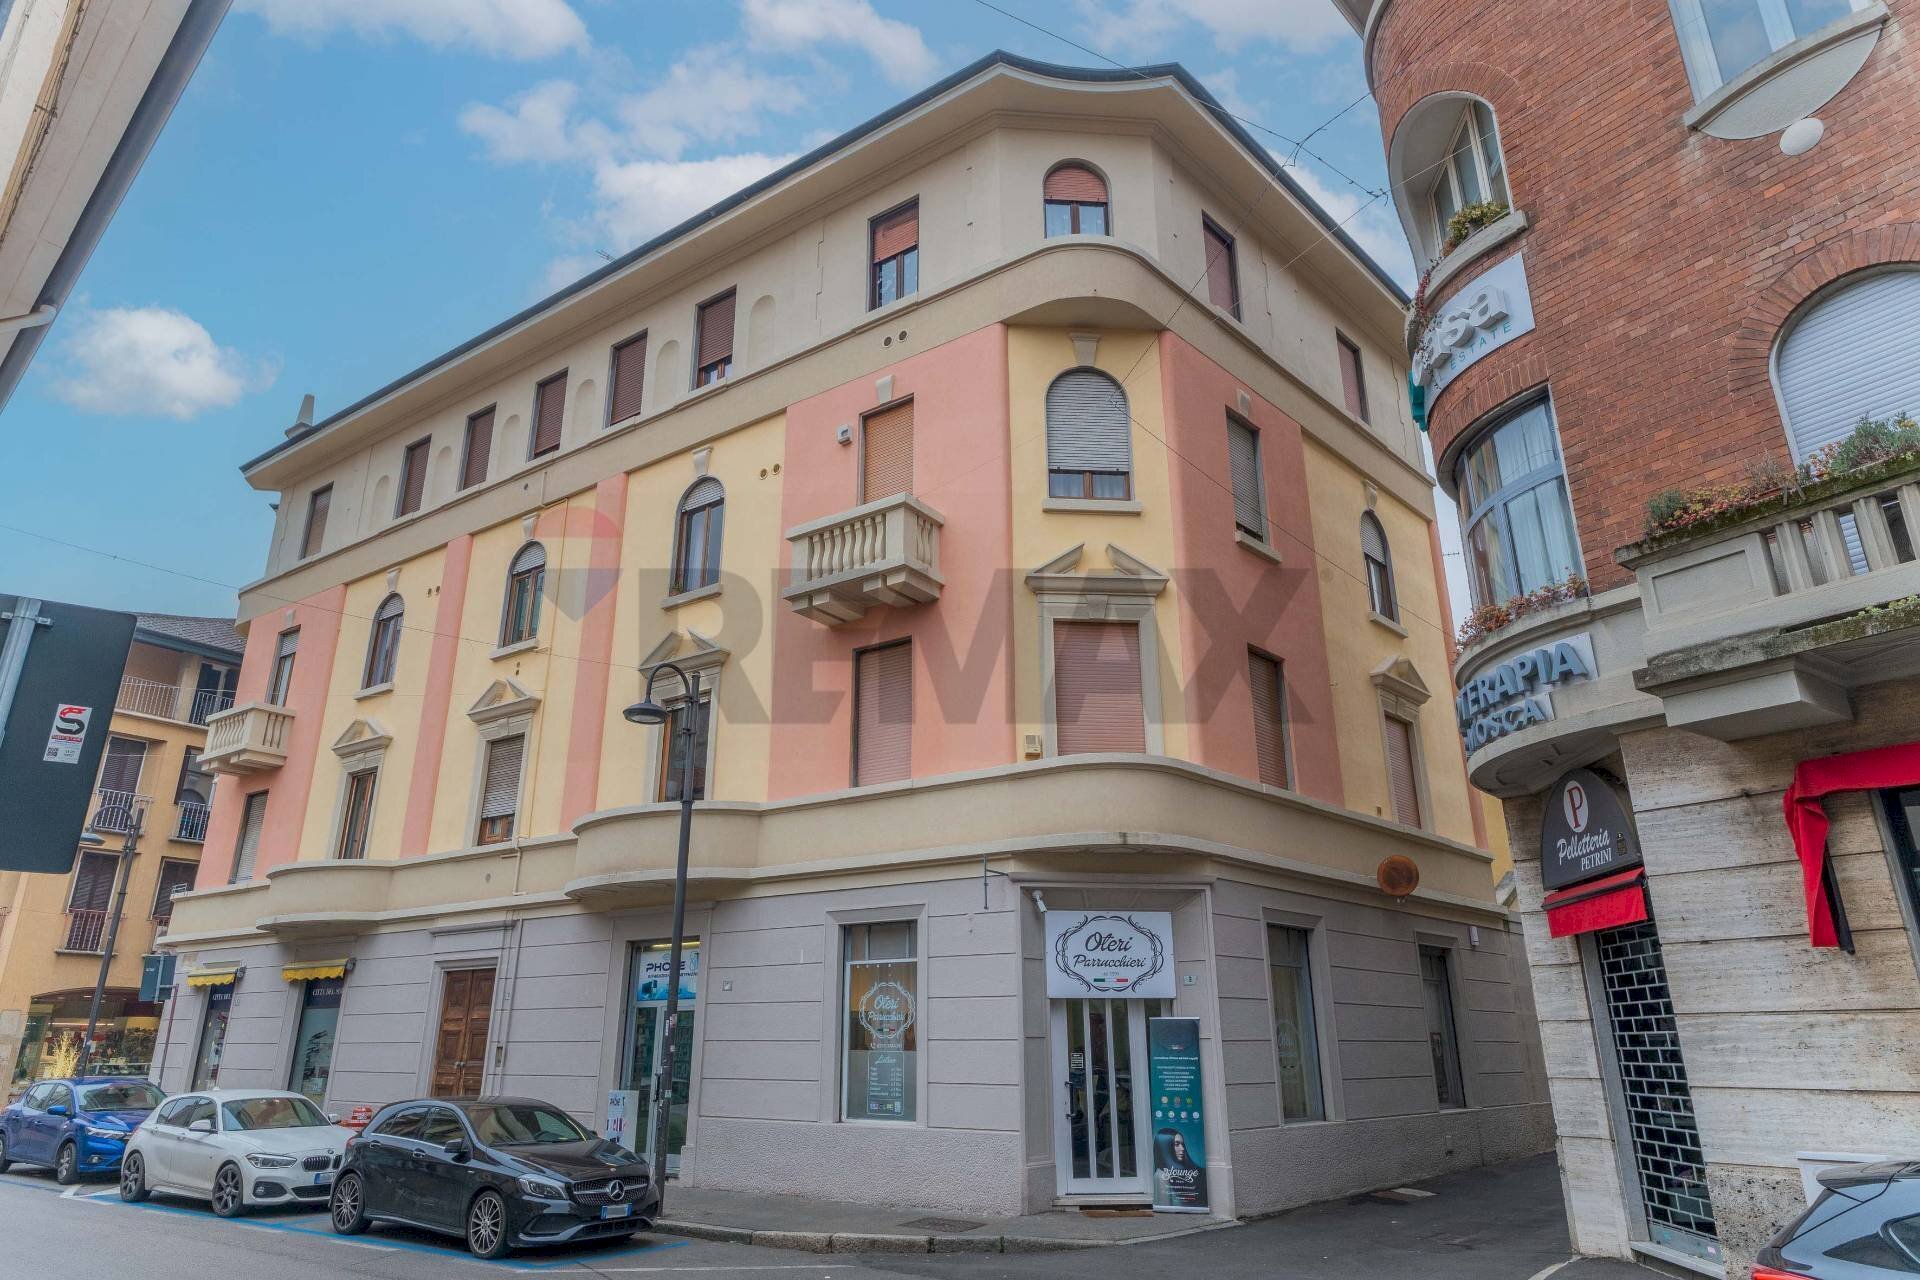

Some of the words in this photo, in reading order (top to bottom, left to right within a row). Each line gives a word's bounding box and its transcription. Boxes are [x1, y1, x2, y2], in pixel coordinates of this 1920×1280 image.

[1567, 786, 1584, 829] P
[1556, 828, 1610, 866] Pelletteria
[1580, 848, 1612, 871] PETRINI
[1085, 931, 1134, 952] Oteri
[646, 960, 687, 973] PHOE
[1073, 954, 1147, 968] Parrucchieri
